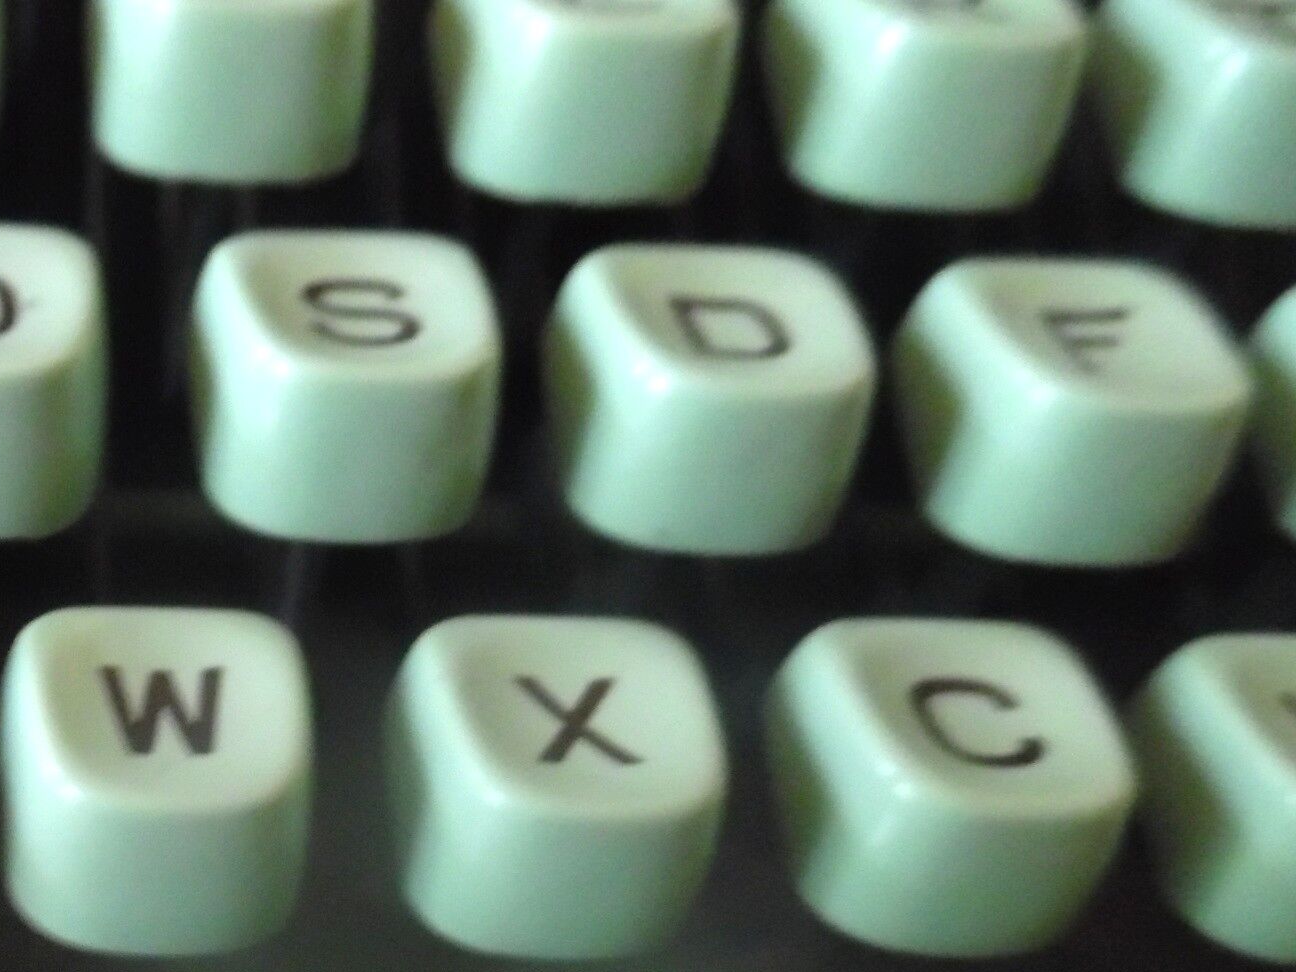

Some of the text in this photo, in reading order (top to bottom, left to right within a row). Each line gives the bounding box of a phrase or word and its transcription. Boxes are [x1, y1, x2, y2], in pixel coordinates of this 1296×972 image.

[301, 277, 423, 347] S
[670, 296, 791, 361] D
[1042, 306, 1130, 377] F
[98, 665, 227, 757] W
[515, 676, 648, 765] X
[911, 677, 1041, 769] C
